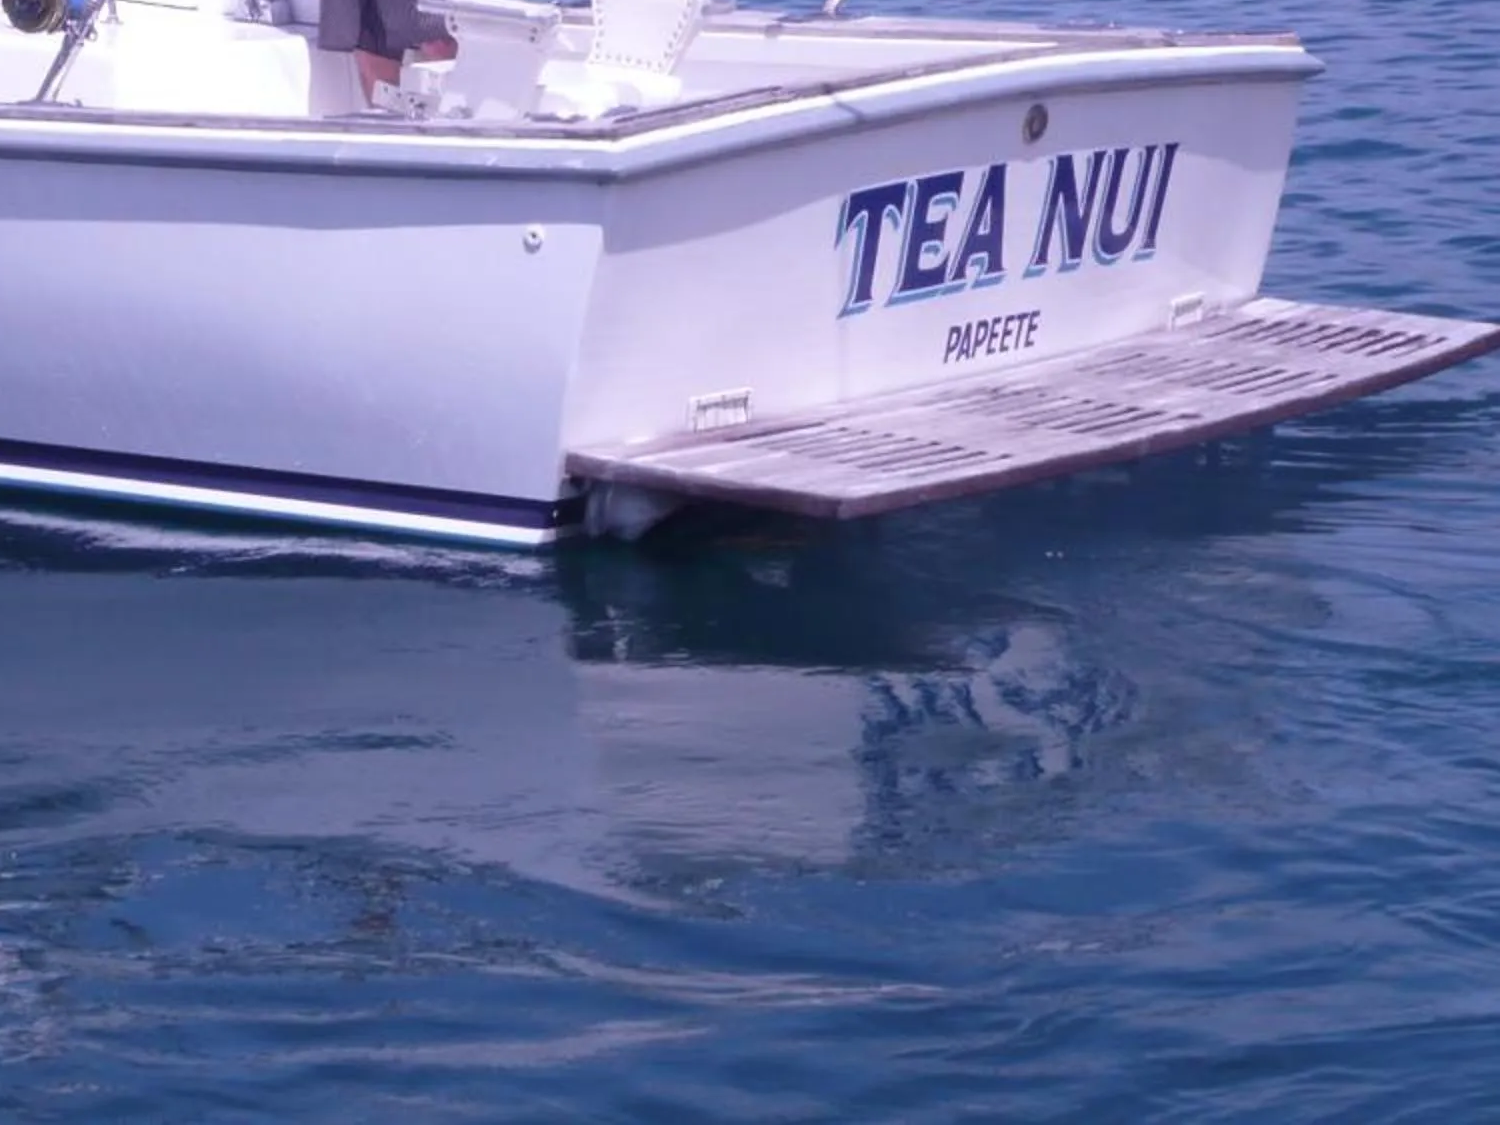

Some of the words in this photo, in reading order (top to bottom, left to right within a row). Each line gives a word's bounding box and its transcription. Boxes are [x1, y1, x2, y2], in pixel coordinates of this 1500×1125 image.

[835, 162, 1008, 319] TEA
[1022, 142, 1181, 280] NUI
[942, 310, 1042, 365] PAPEETE
